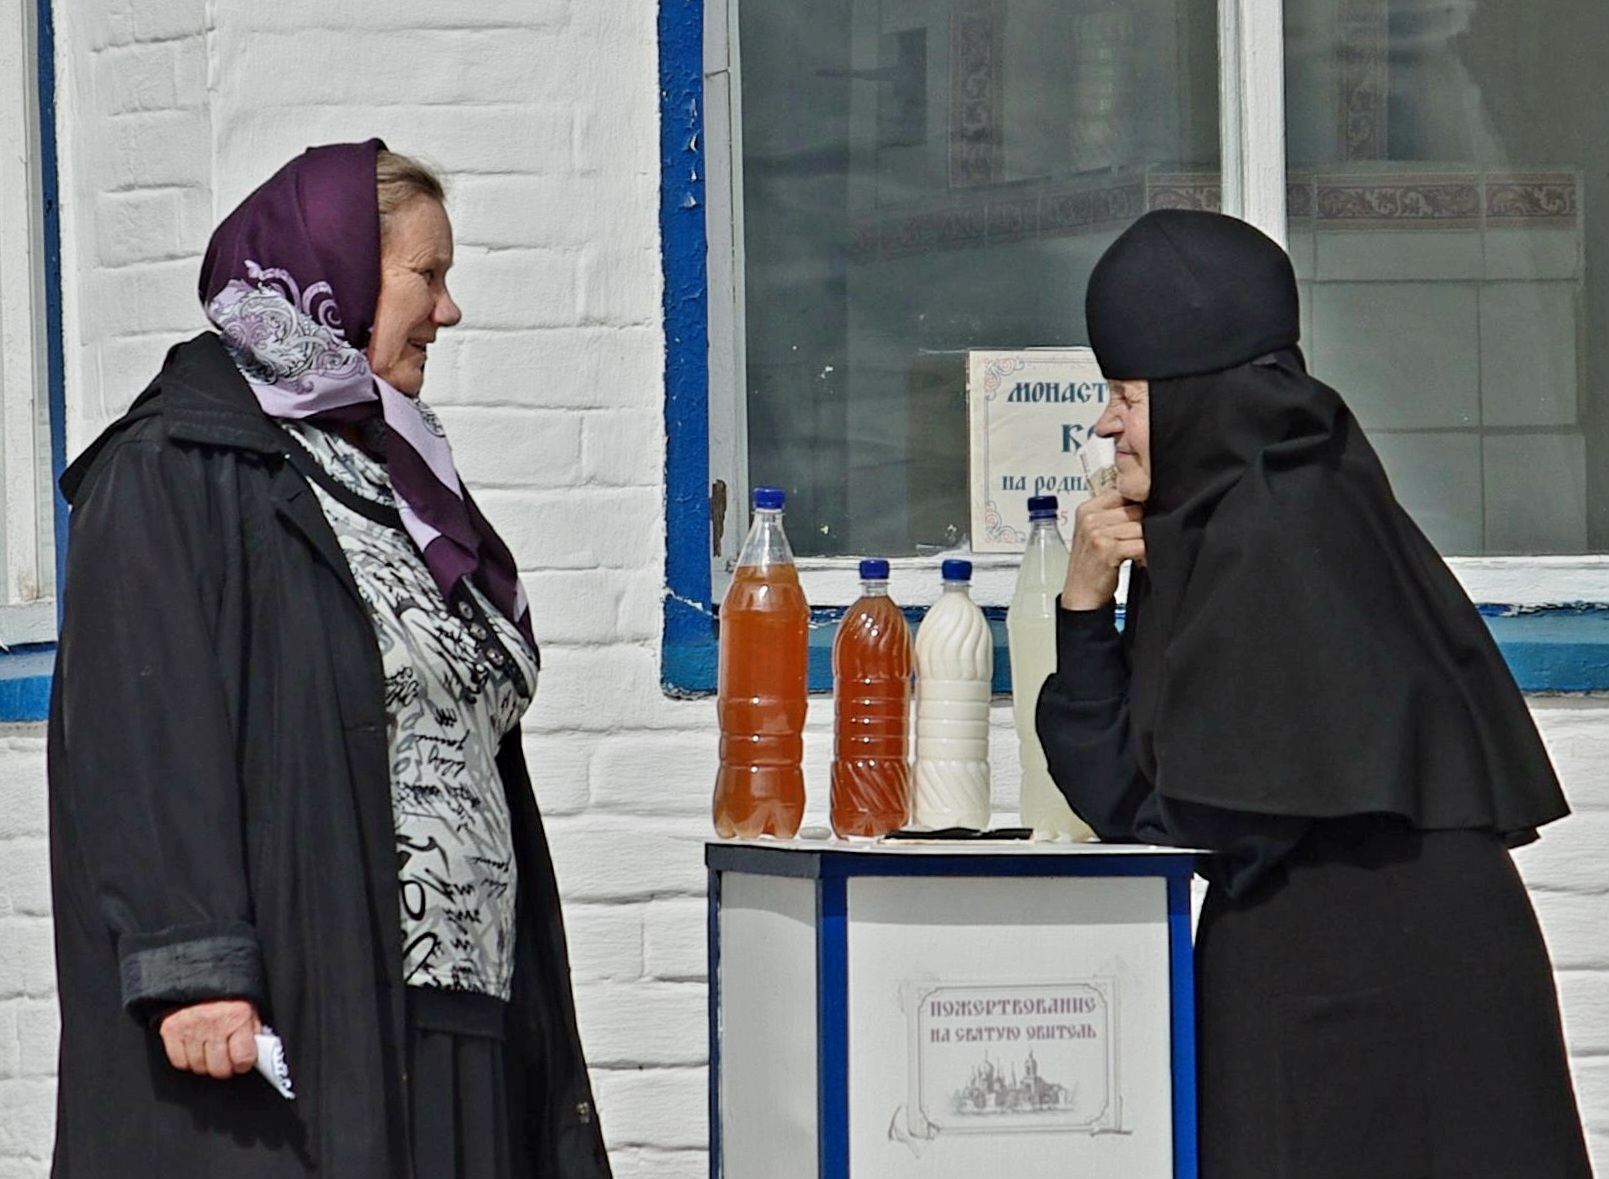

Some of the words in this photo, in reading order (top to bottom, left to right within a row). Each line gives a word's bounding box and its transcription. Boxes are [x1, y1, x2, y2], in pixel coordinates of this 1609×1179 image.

[930, 997, 1096, 1017] ПОЖЕРТВОВАНИЕ
[930, 1027, 950, 1043] НА
[955, 1026, 1021, 1042] СВЯТУЮ
[1026, 1023, 1097, 1040] ОБИТЕЛЬ
